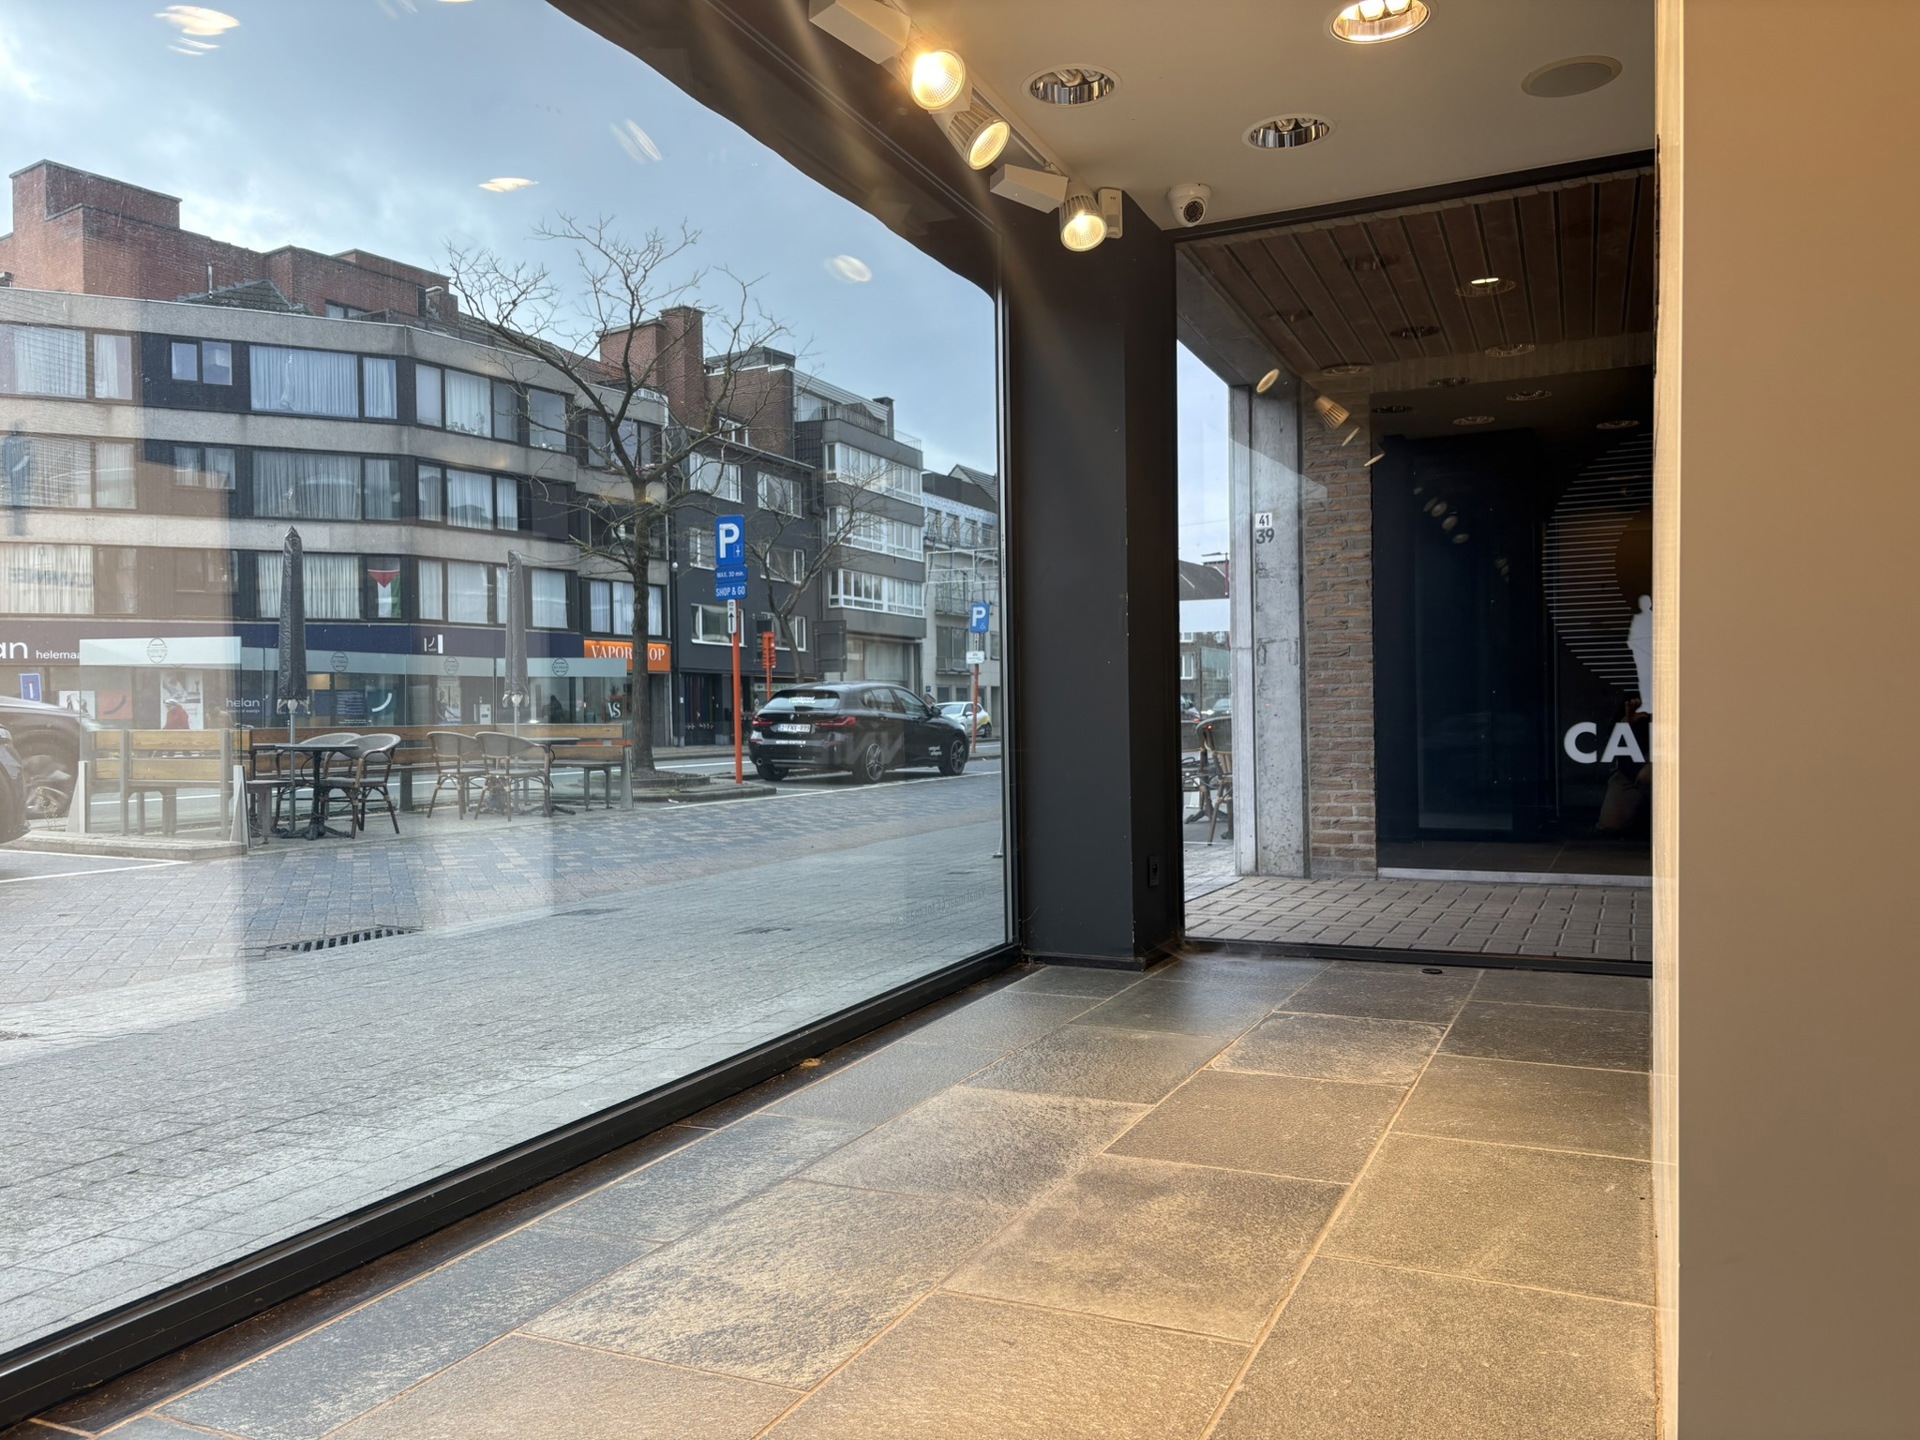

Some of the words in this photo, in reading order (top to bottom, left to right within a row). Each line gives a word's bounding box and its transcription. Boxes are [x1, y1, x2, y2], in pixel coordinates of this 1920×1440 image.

[1258, 514, 1270, 527] 41
[718, 522, 740, 559] P
[1256, 527, 1275, 545] 39
[715, 586, 731, 597] SHOP
[731, 585, 737, 596] &
[737, 585, 746, 596] GO
[971, 606, 987, 627] P
[591, 644, 666, 661] VAPOROP
[225, 697, 260, 708] helan
[607, 702, 621, 718] VS
